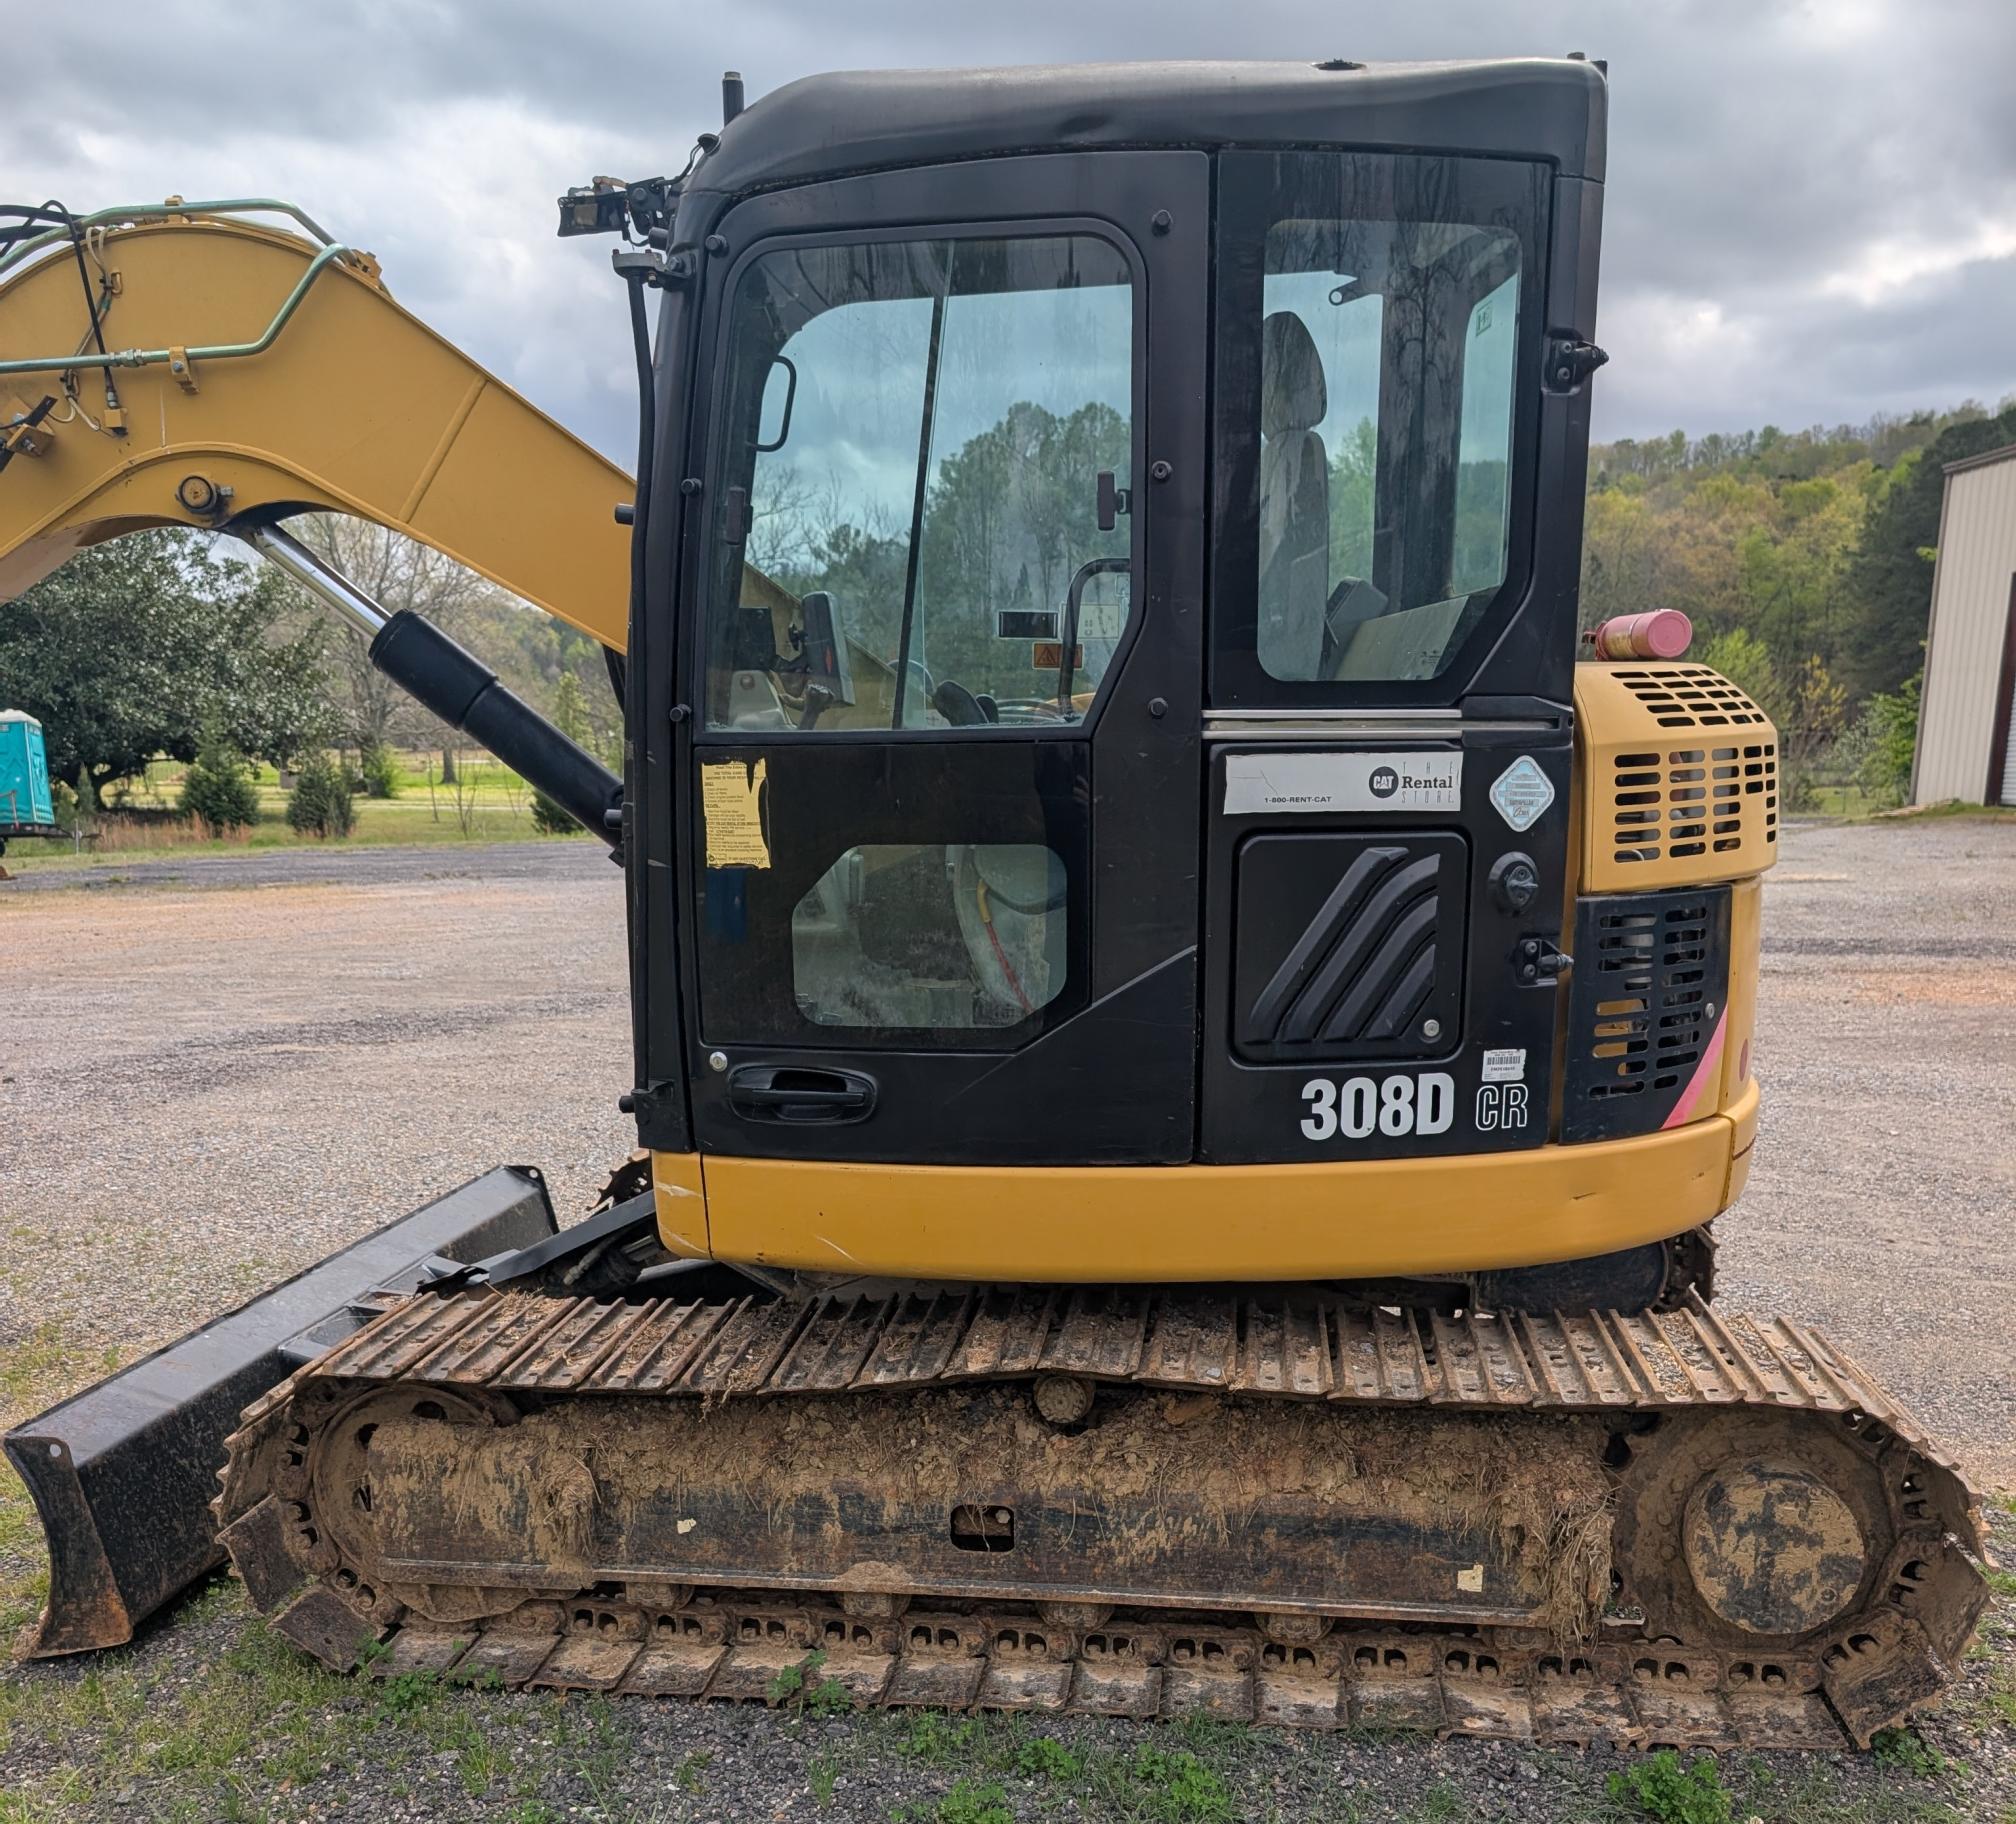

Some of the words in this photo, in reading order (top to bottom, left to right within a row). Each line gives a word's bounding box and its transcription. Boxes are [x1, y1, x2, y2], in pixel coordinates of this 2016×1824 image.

[1402, 761, 1454, 775] THE
[1372, 775, 1395, 790] CAT
[1401, 775, 1453, 790] Rental
[1264, 796, 1332, 804] 1-800-RENT-CAT
[1300, 1072, 1455, 1141] 308D
[1475, 1083, 1529, 1131] CR
